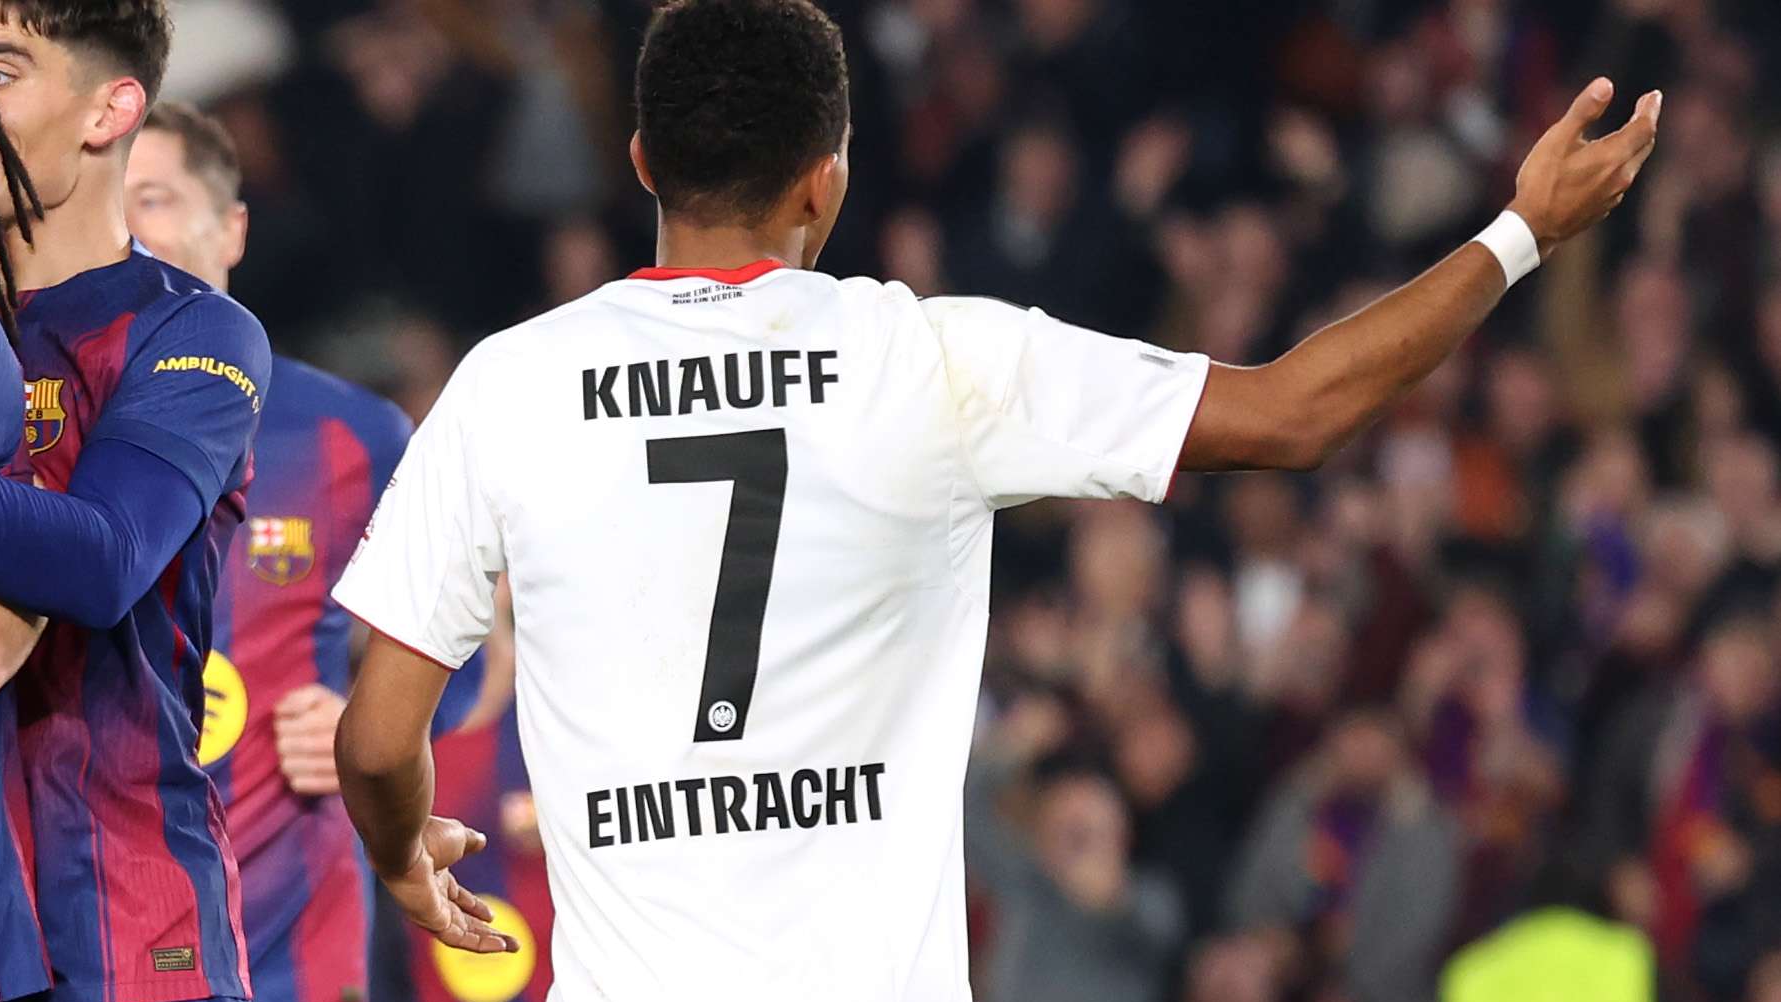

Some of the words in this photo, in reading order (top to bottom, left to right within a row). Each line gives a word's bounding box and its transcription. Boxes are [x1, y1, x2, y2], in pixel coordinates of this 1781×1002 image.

[152, 356, 256, 397] AMBILIGHT
[582, 350, 839, 420] KNAUFF
[645, 427, 789, 743] 7
[585, 763, 886, 848] EINTRACHT
